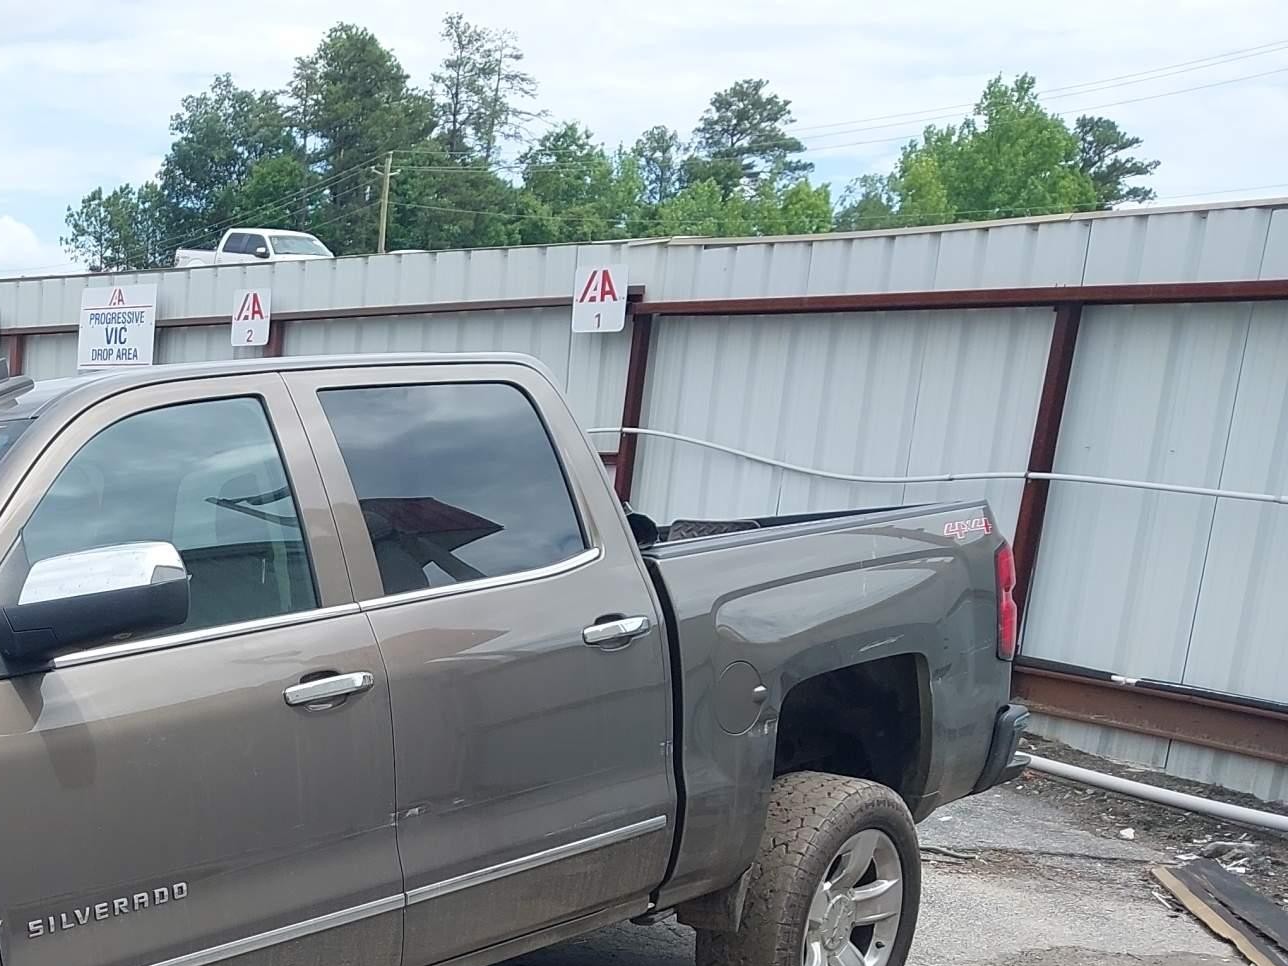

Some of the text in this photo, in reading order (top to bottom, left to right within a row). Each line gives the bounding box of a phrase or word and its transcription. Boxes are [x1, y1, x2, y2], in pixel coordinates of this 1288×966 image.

[89, 311, 145, 325] PROGRESSIVE
[594, 312, 601, 329] 1
[105, 326, 128, 345] VIC
[246, 328, 254, 343] 2
[91, 347, 139, 361] DROP AREA
[27, 881, 189, 939] SILVERADO
